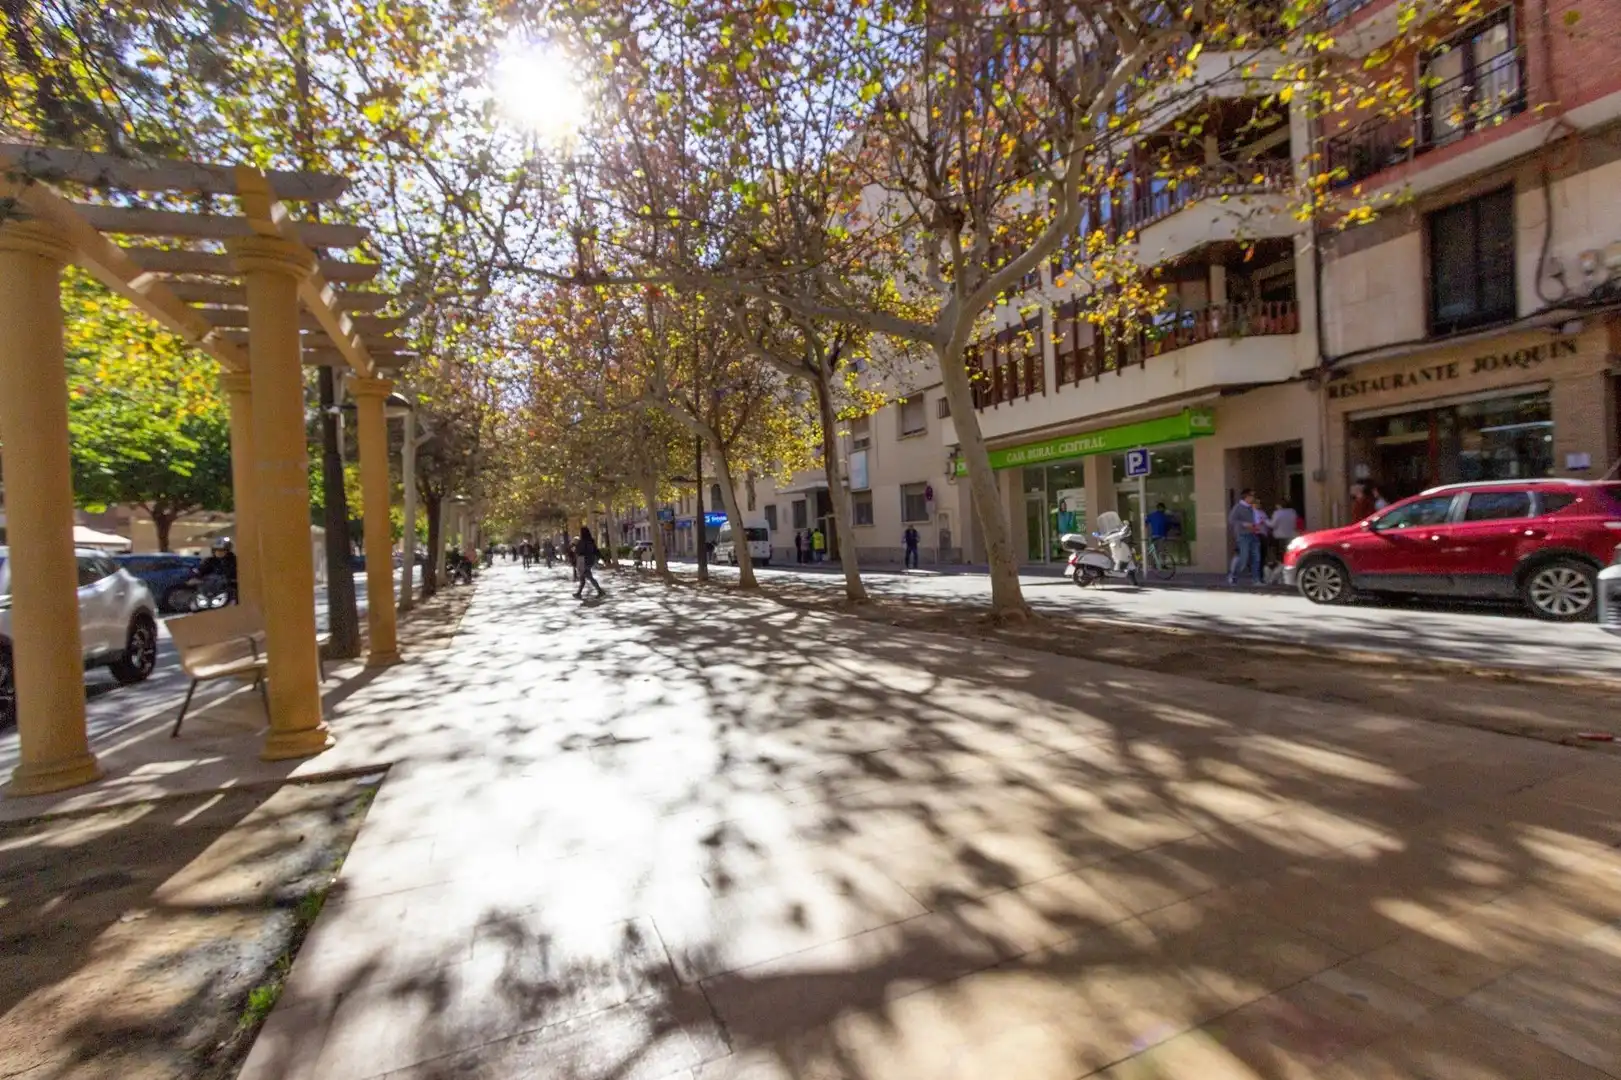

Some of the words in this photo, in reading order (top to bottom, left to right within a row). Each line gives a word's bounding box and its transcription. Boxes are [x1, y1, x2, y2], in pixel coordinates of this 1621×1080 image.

[1328, 361, 1459, 399] RESTAURANTE
[1058, 437, 1106, 454] CENTRAL
[1128, 452, 1143, 474] P
